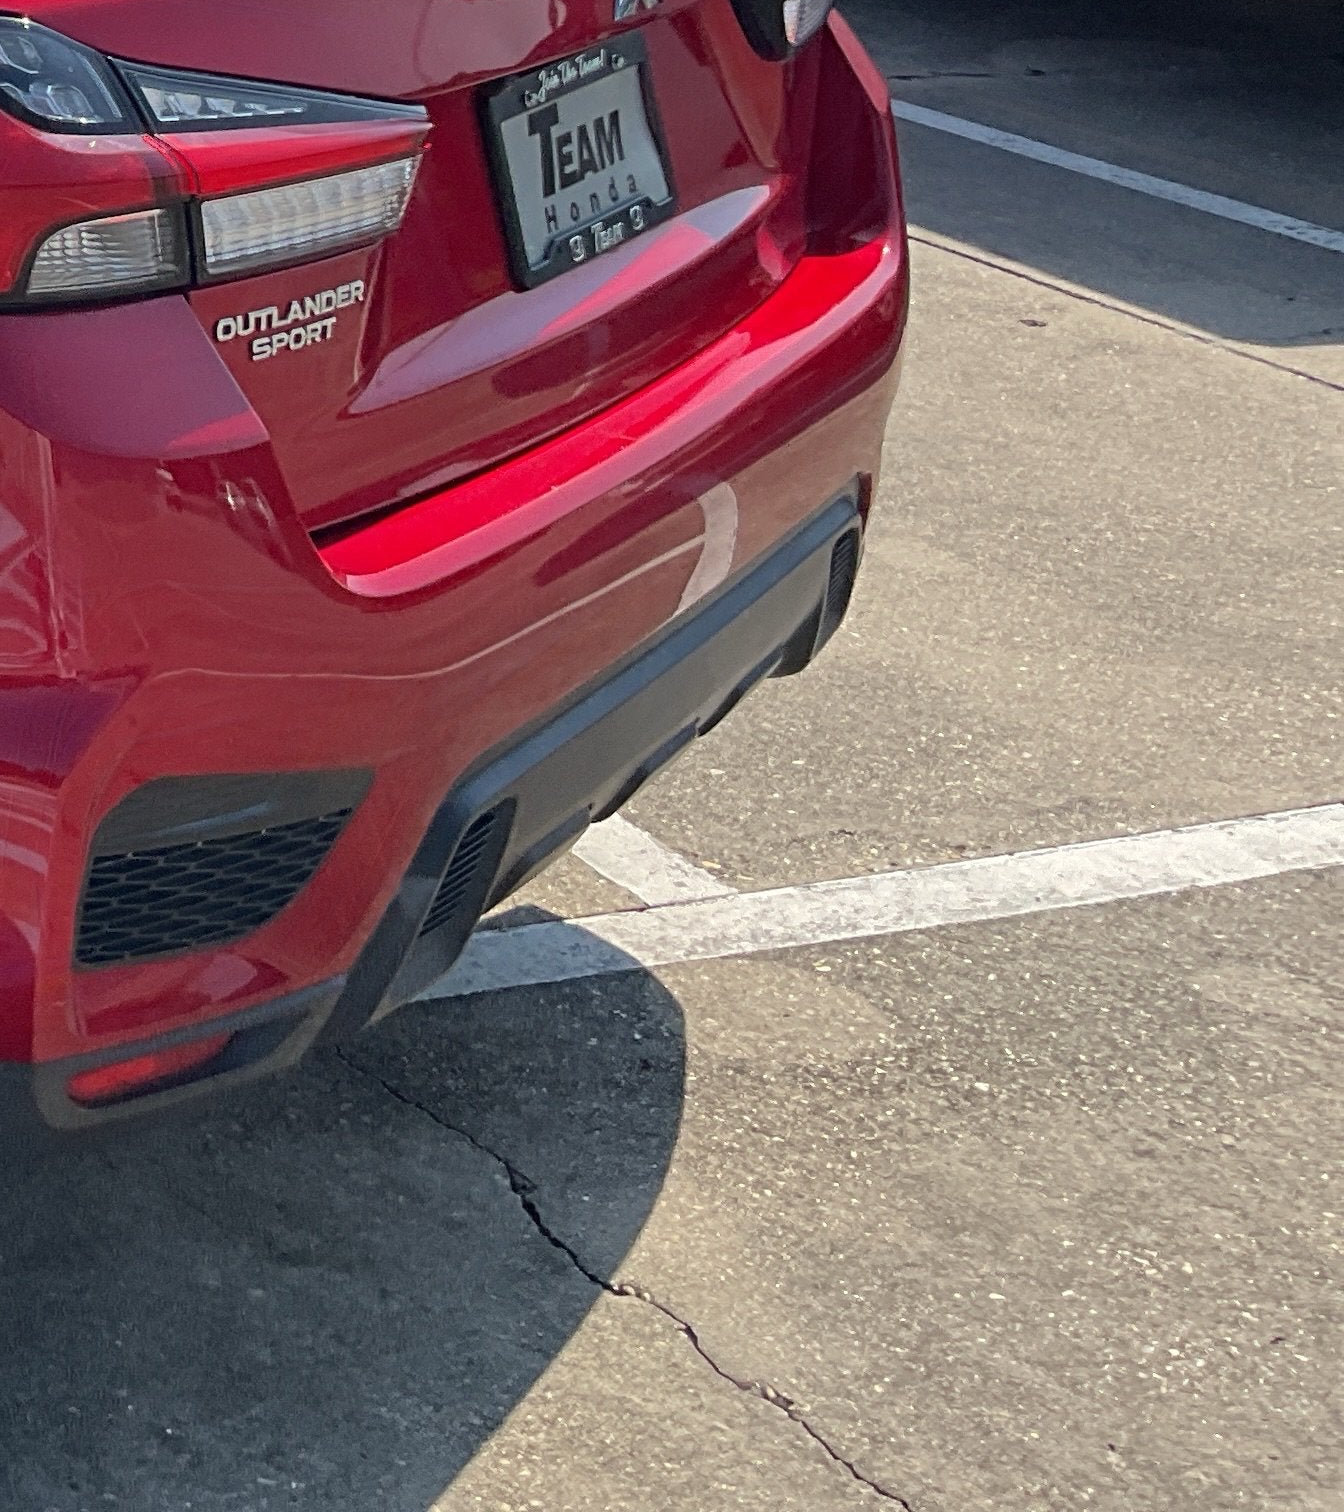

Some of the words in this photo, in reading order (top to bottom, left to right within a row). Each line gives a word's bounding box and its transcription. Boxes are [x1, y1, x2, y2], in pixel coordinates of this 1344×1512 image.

[544, 174, 638, 234] Honda
[216, 279, 365, 343] OUTLANDER
[251, 316, 337, 362] SPORT
